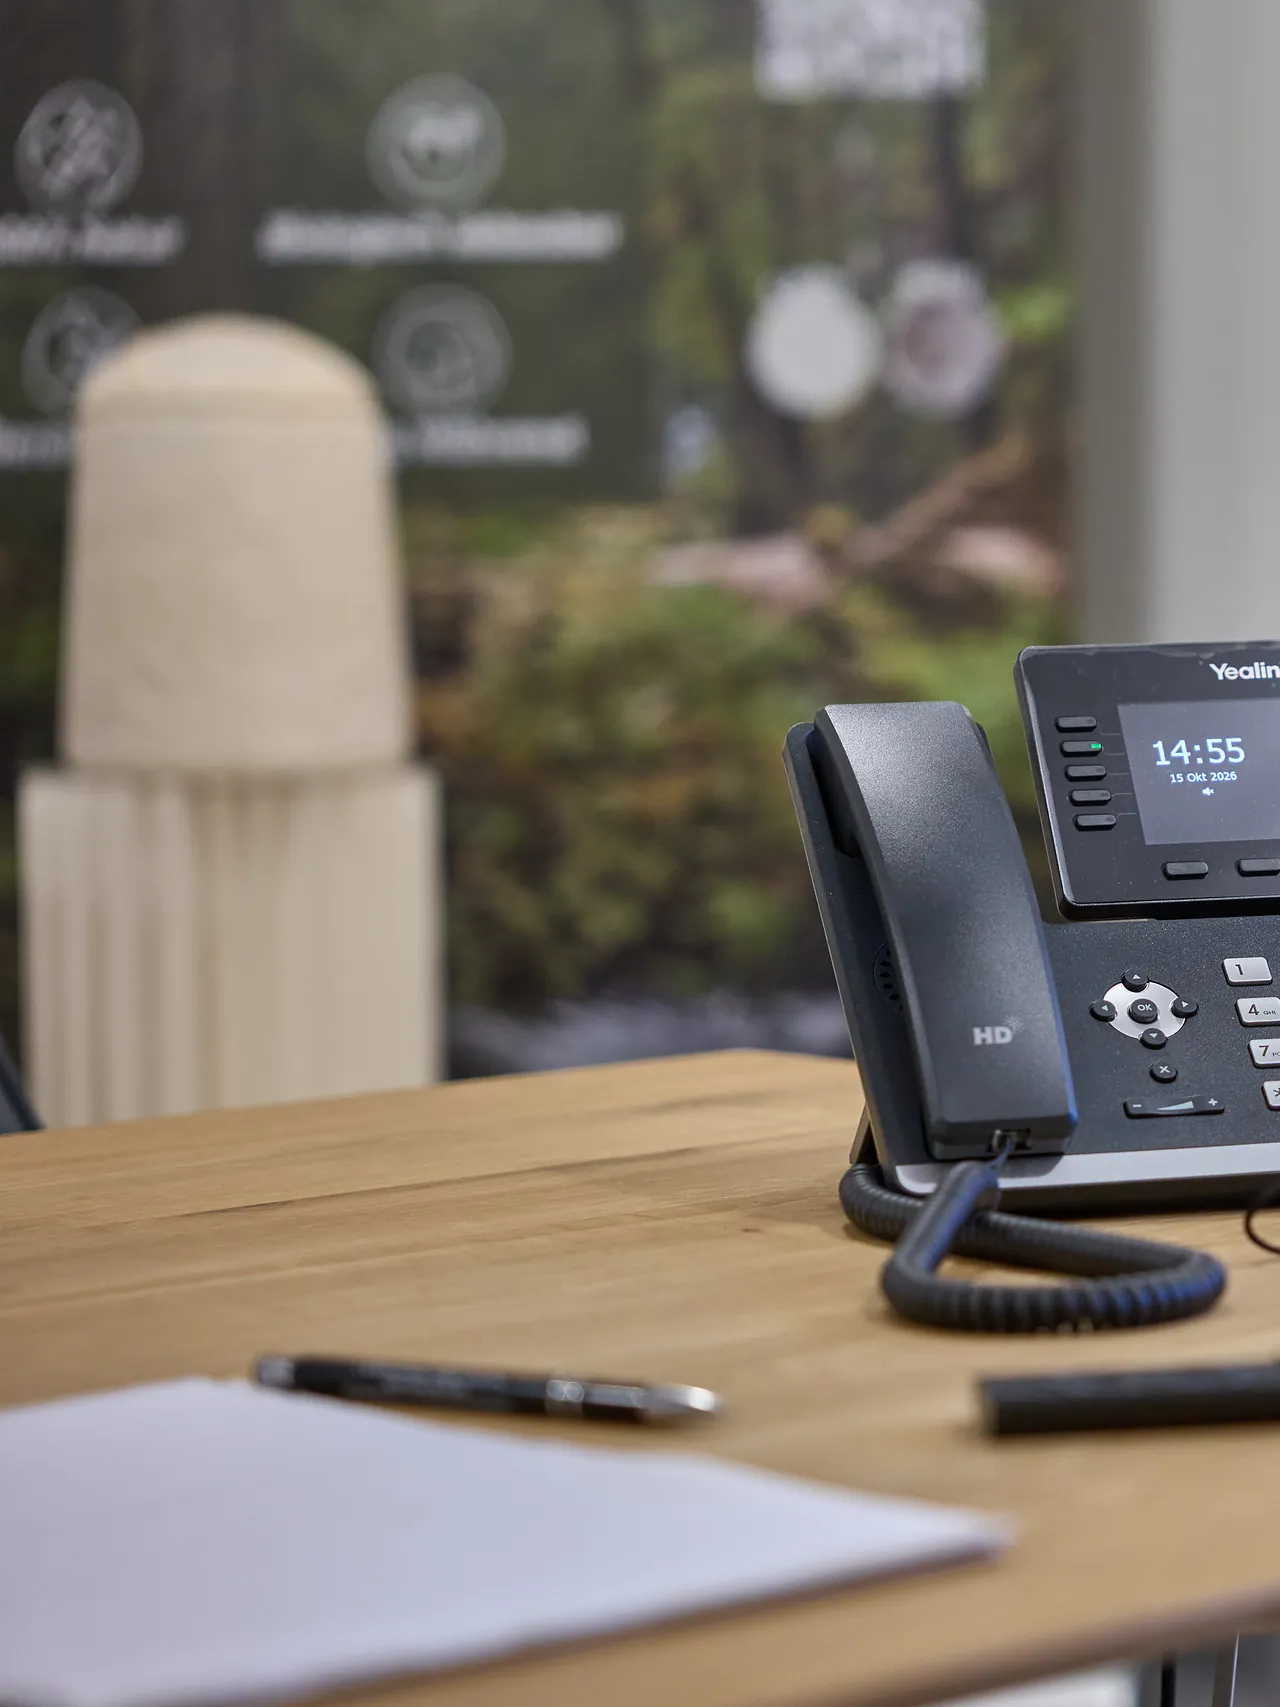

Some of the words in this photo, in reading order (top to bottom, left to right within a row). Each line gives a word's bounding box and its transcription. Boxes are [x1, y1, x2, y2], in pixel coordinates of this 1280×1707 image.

[1152, 737, 1245, 766] 14:55
[1169, 773, 1184, 783] 15
[1186, 772, 1207, 782] Okt
[1210, 771, 1238, 782] 2026
[1235, 964, 1244, 975] 1
[1137, 1003, 1153, 1012] OK
[1248, 1004, 1260, 1016] 4
[972, 1026, 1013, 1045] HD
[1258, 1044, 1270, 1057] 7
